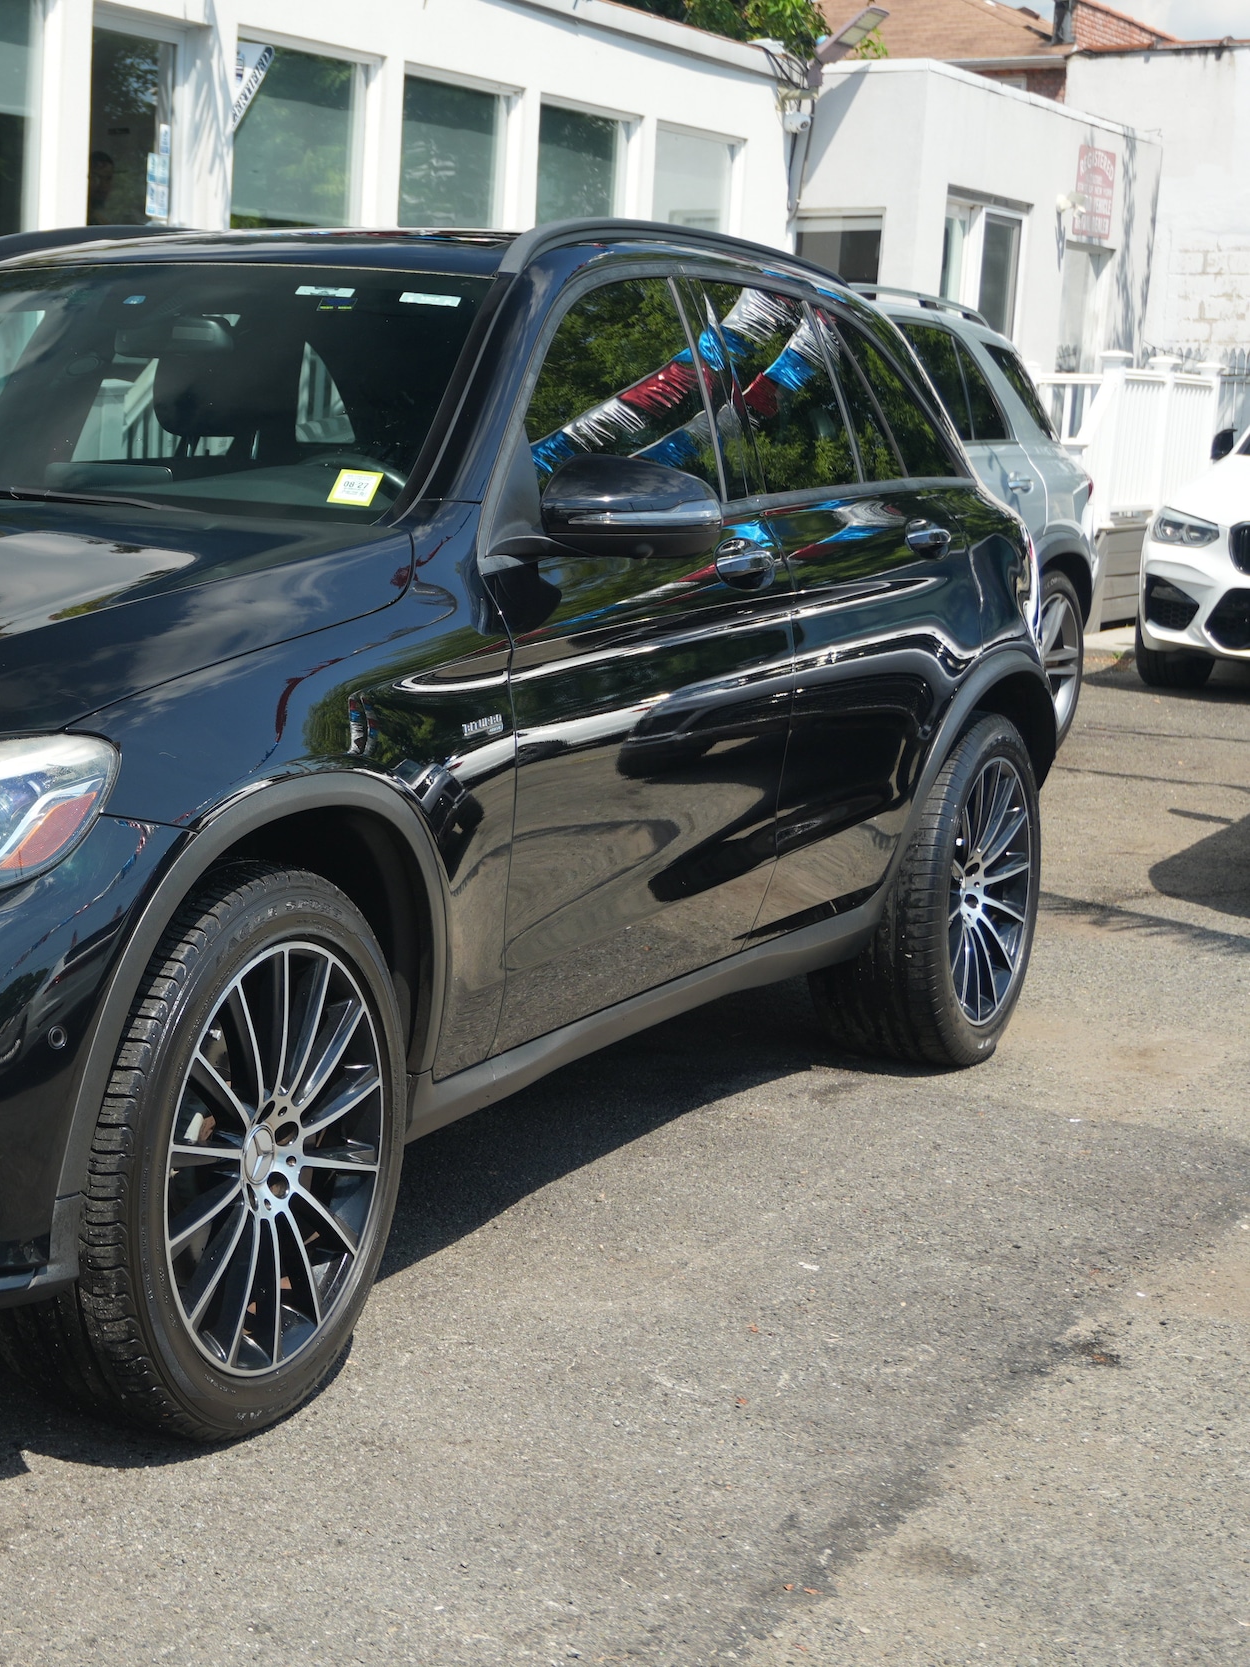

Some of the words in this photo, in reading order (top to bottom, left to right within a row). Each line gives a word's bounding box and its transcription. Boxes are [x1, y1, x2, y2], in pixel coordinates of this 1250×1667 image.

[1080, 150, 1114, 181] REGISTERED
[1093, 197, 1111, 216] VEHICLE
[1092, 215, 1109, 234] DEALER
[343, 480, 355, 488] 08
[284, 898, 344, 919] SPORT
